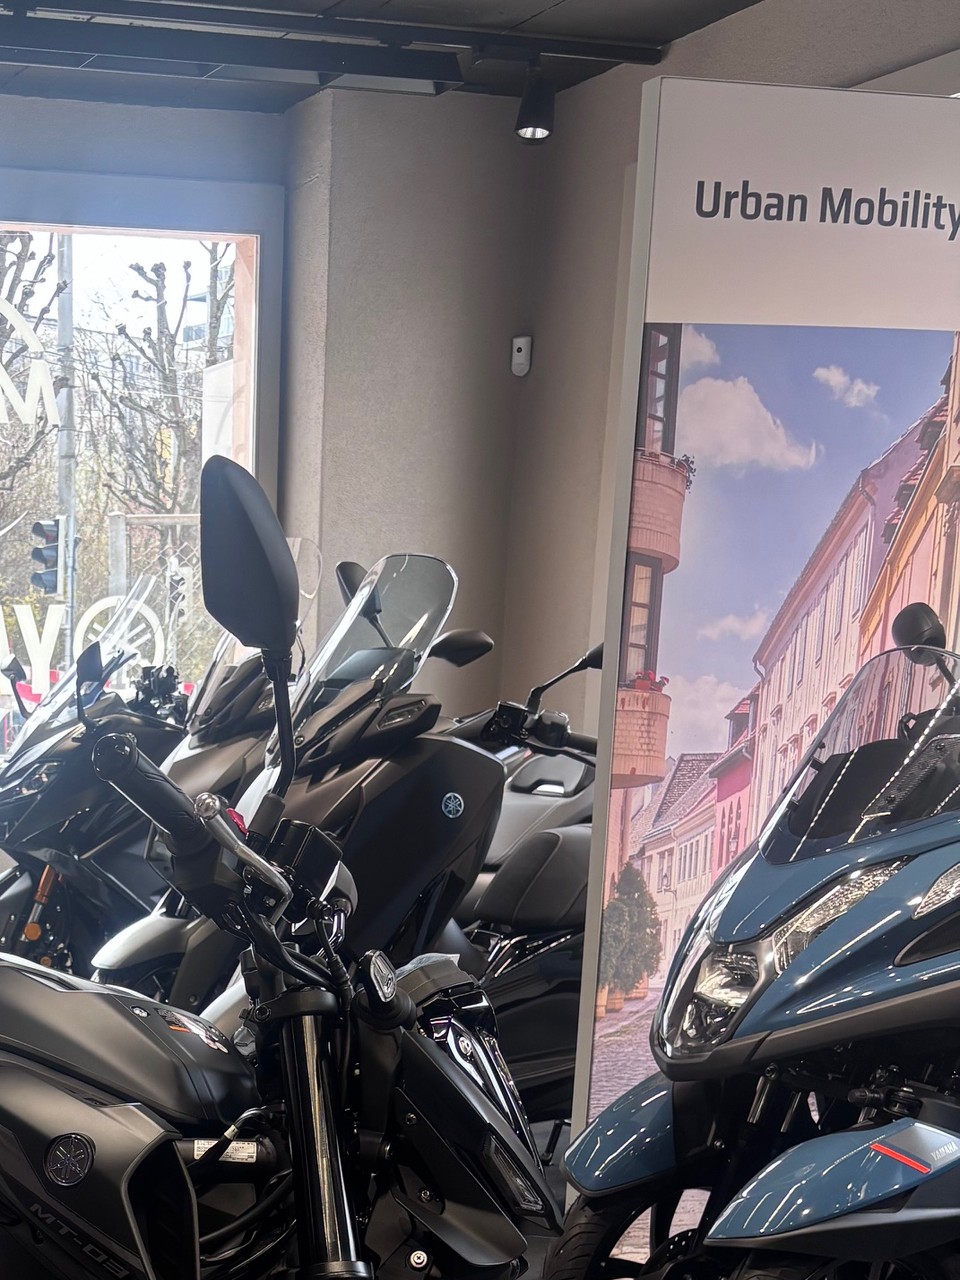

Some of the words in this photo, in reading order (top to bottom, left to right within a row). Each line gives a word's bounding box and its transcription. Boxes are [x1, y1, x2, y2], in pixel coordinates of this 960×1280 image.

[695, 180, 808, 222] Urban
[819, 186, 960, 241] Mobility
[930, 1141, 959, 1161] YAMAHA
[29, 1203, 130, 1279] MT-03
